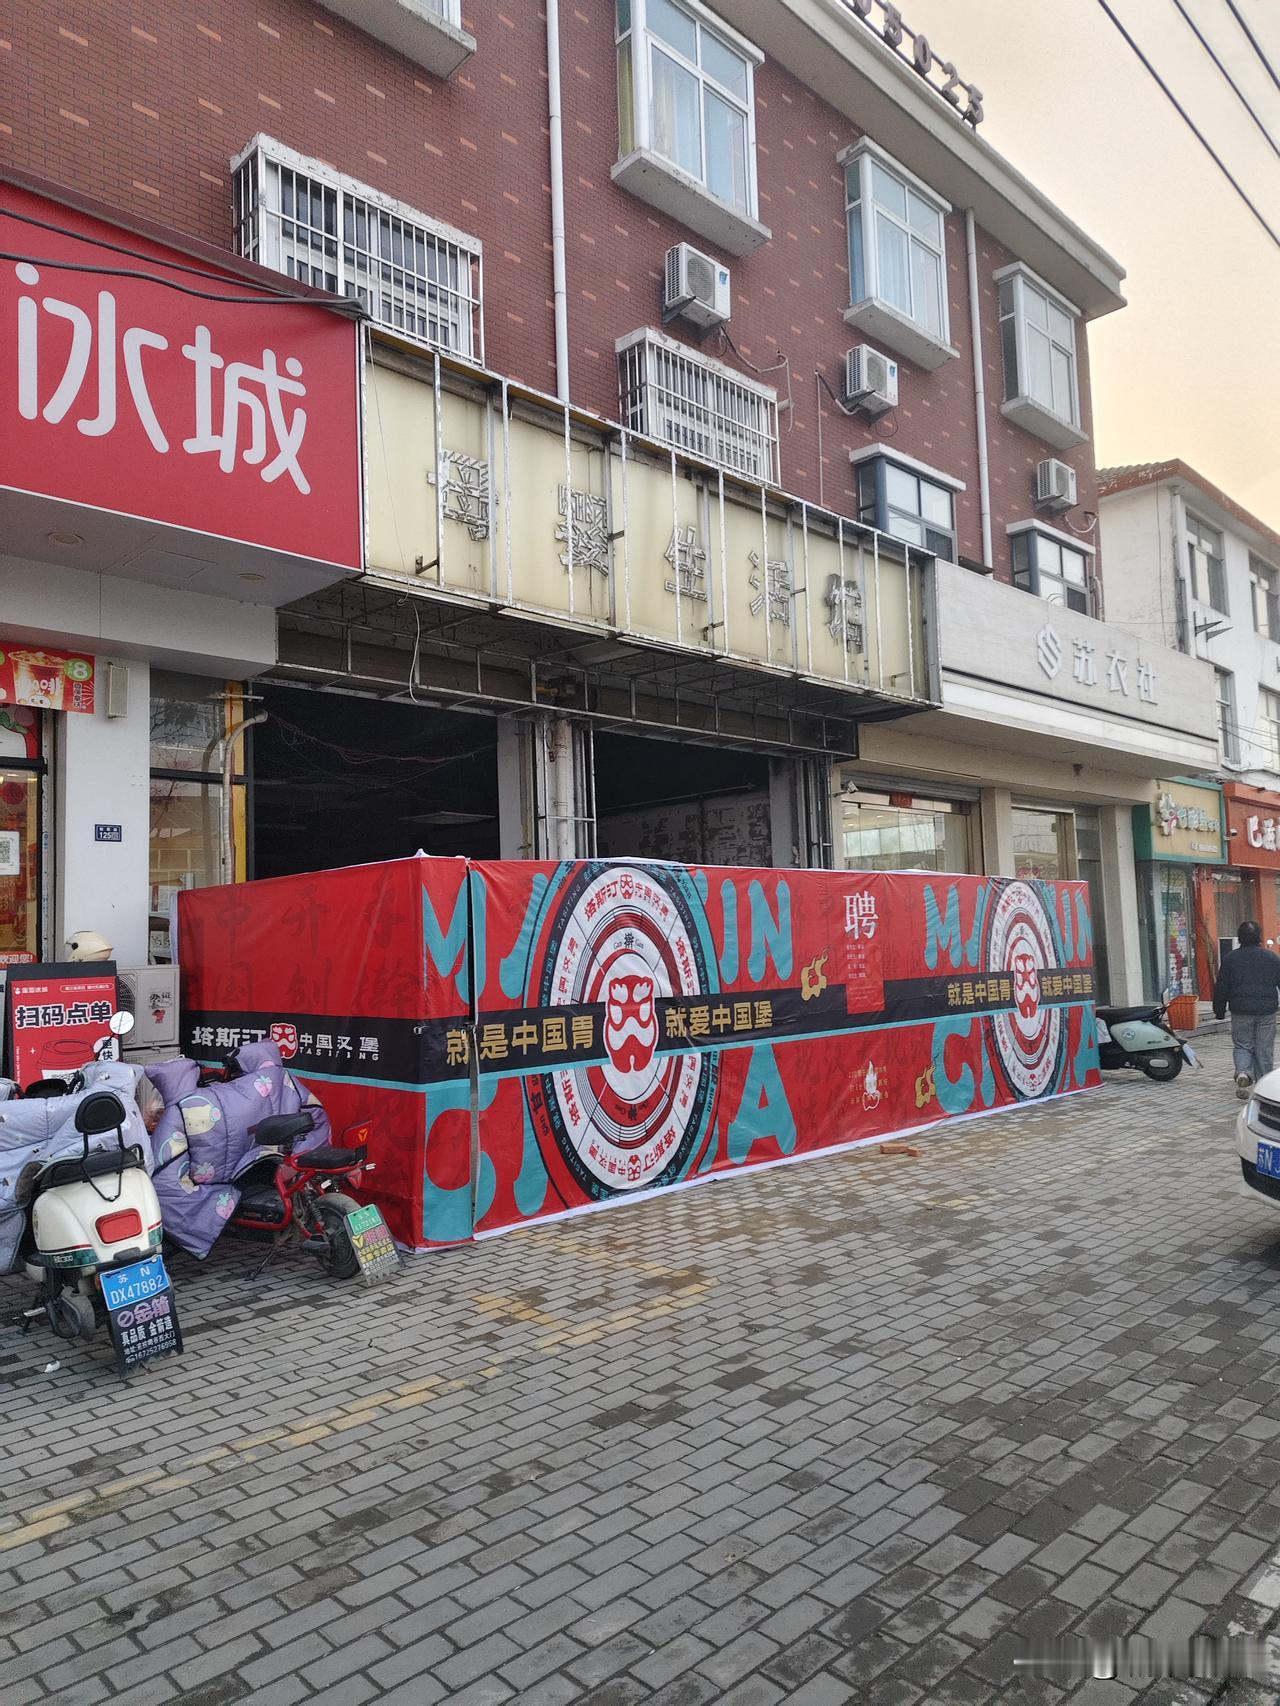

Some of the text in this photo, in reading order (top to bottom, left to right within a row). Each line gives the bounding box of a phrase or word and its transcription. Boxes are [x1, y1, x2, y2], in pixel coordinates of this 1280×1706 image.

[15, 262, 311, 495] 冰城
[584, 880, 619, 921] 塔斯汀
[843, 890, 879, 940] 聘
[15, 1001, 112, 1029] 扫码点单
[191, 1026, 379, 1053] 塔斯汀 中国汉堡
[446, 1000, 773, 1066] 就是中国胃 就爱中国堡
[110, 1274, 164, 1304] DX47882
[118, 1265, 151, 1284] 苏 N
